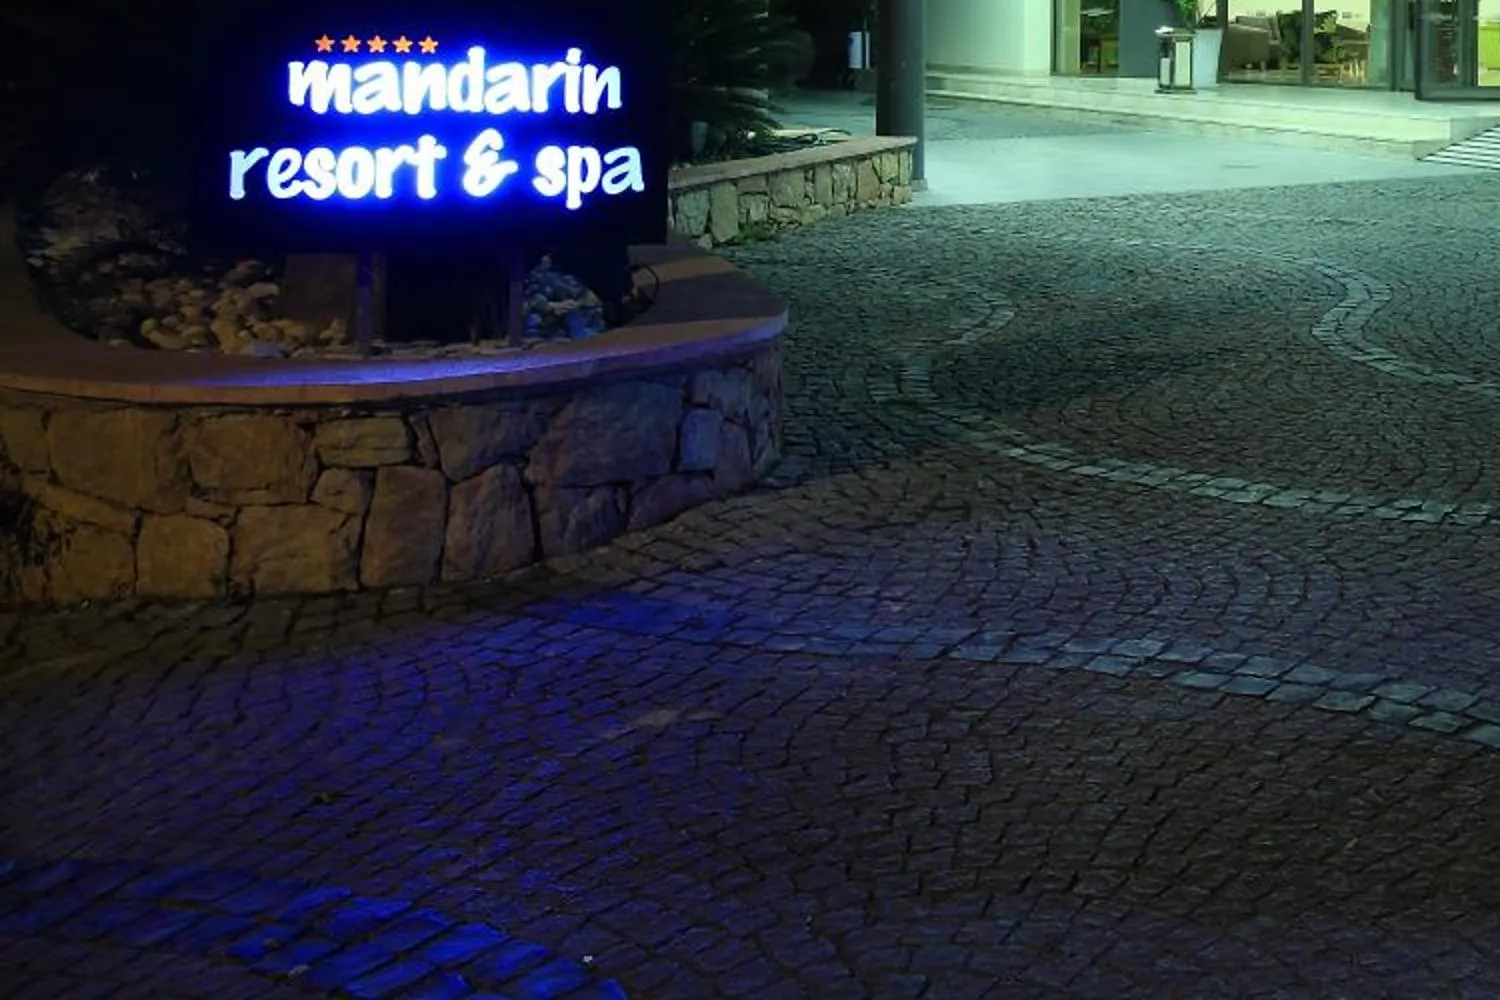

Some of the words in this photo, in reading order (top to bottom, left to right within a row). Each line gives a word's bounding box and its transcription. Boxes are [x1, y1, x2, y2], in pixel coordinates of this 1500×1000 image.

[288, 46, 623, 115] mandarin
[228, 134, 447, 200] resort
[463, 128, 519, 198] &
[532, 145, 645, 210] spa
